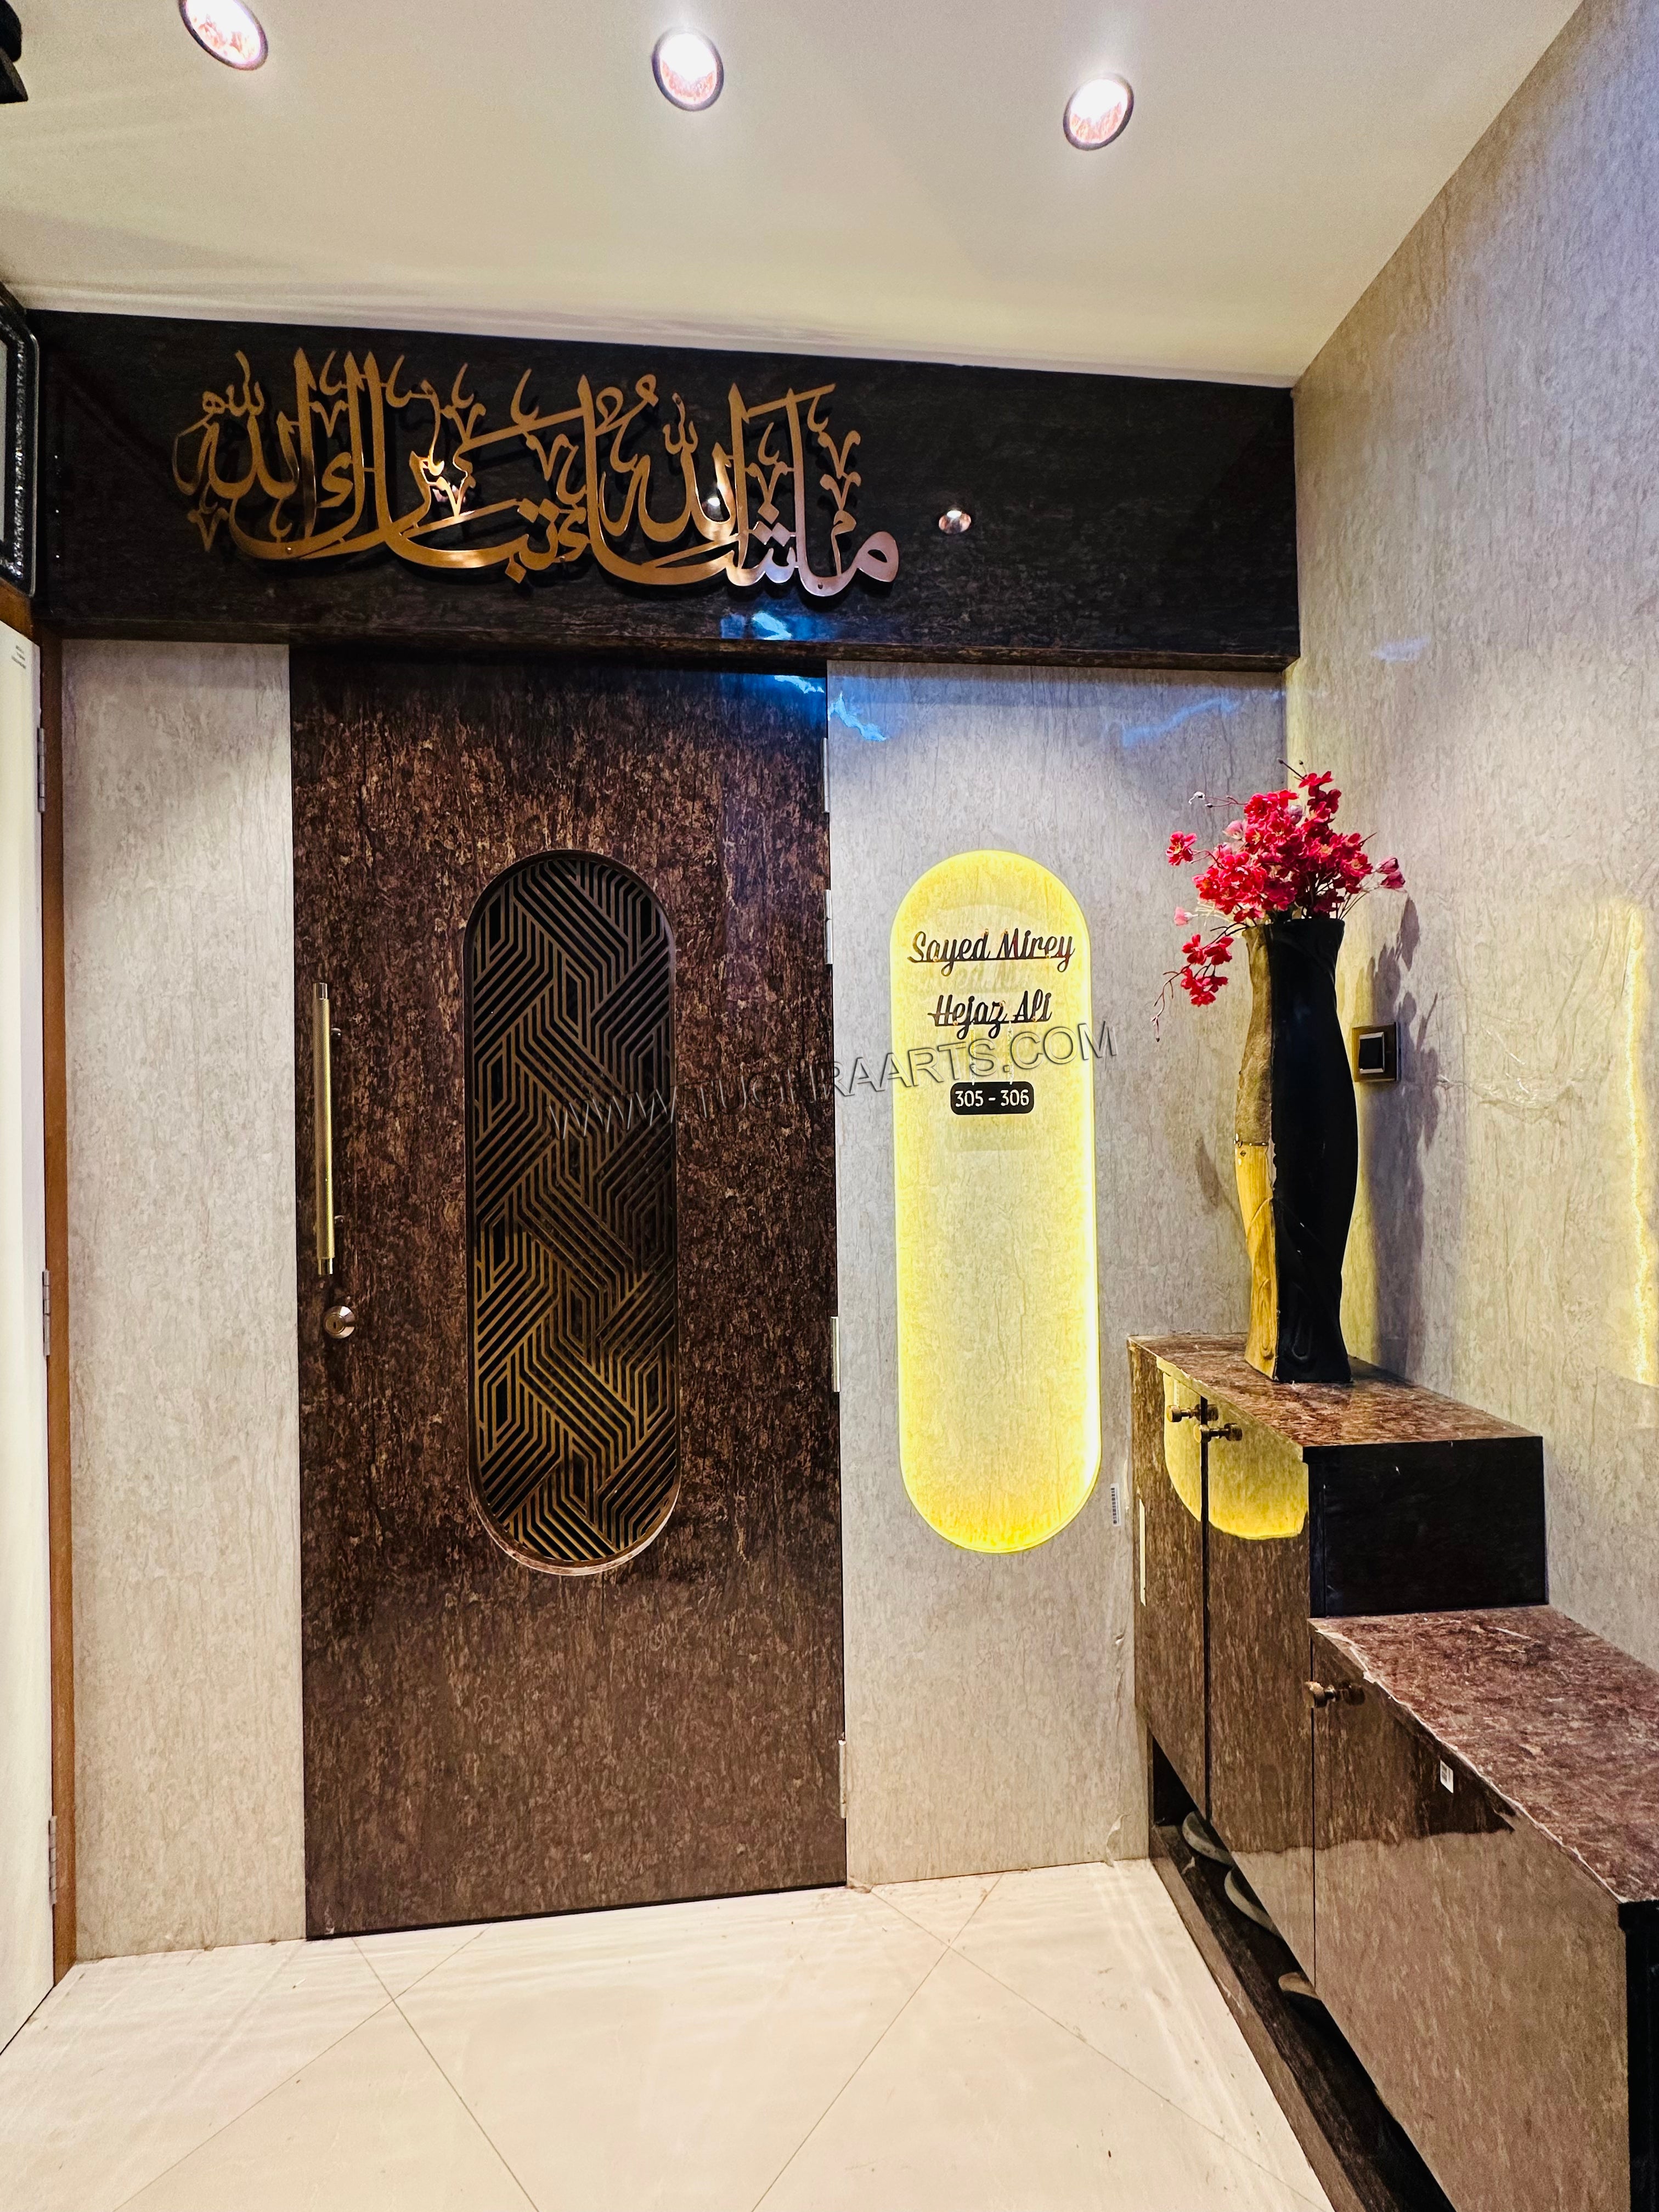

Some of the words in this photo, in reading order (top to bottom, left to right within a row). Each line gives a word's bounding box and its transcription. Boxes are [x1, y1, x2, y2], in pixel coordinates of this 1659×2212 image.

[907, 928, 991, 977] Sayed
[996, 928, 1075, 973] Mirey
[927, 994, 1008, 1039] Hejaz
[1013, 989, 1052, 1024] Ali
[955, 1090, 984, 1107] 305
[1000, 1089, 1030, 1107] 306
